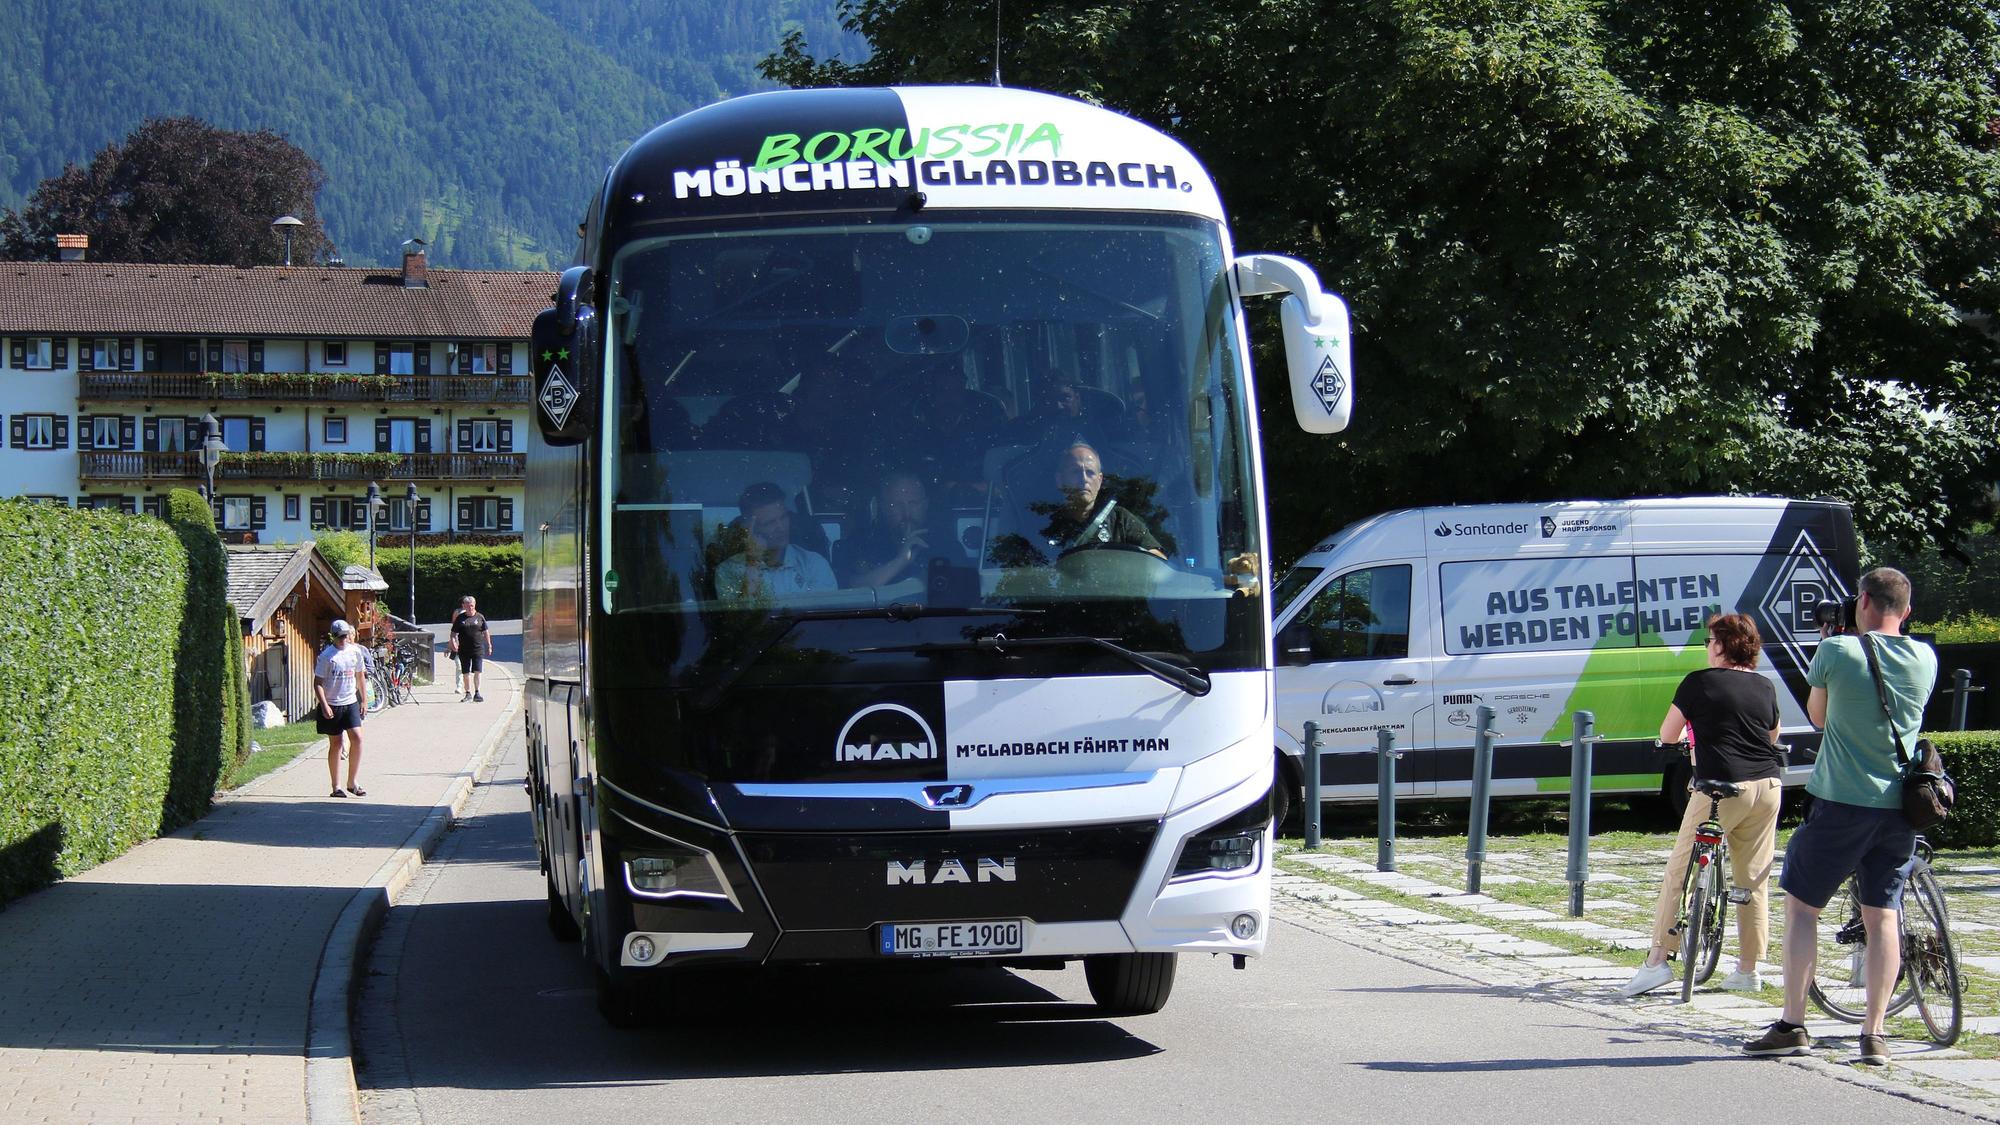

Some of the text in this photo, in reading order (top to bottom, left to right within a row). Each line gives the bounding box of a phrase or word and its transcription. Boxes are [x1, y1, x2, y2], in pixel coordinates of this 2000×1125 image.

[753, 122, 1064, 172] BORUSSIA
[674, 160, 910, 199] MÖNCHEN
[1454, 522, 1529, 537] Santander
[1487, 574, 1721, 616] AUS TALENTEN
[1460, 615, 1590, 649] WERDEN
[1326, 701, 1379, 714] MAN
[1443, 694, 1473, 705] PUMA
[1494, 693, 1551, 701] PORSCHE
[845, 742, 928, 761] MAN
[1074, 737, 1129, 754] FÄHRT
[1133, 738, 1169, 752] MAN
[887, 857, 1017, 886] MAN
[896, 924, 1018, 949] MG FE 1900
